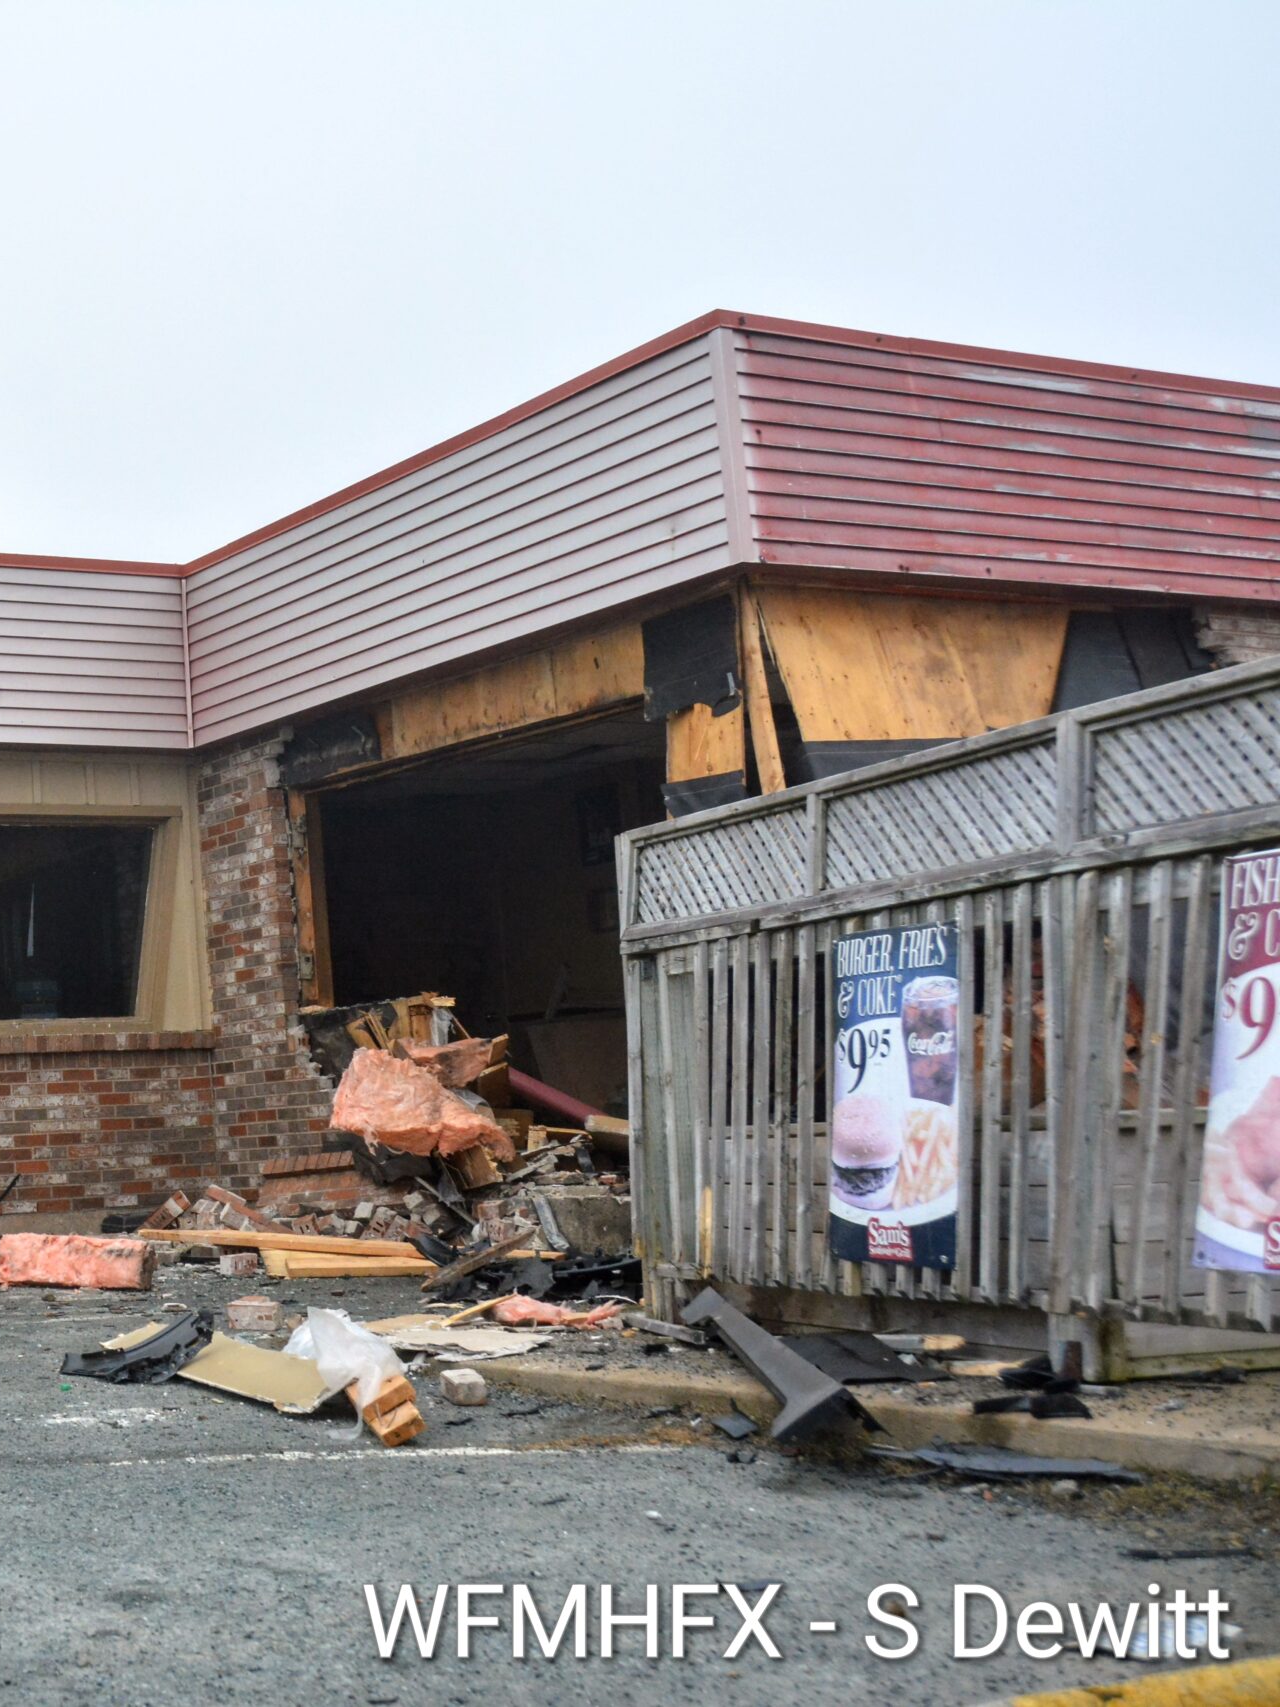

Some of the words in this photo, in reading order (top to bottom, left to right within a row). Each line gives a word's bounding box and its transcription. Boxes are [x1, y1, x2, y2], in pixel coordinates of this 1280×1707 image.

[1230, 857, 1280, 909] FISH
[837, 934, 895, 978] BURGER,
[898, 926, 947, 970] FRIES
[1228, 912, 1260, 961] &
[837, 981, 855, 1019] &
[868, 1220, 910, 1247] Sam's
